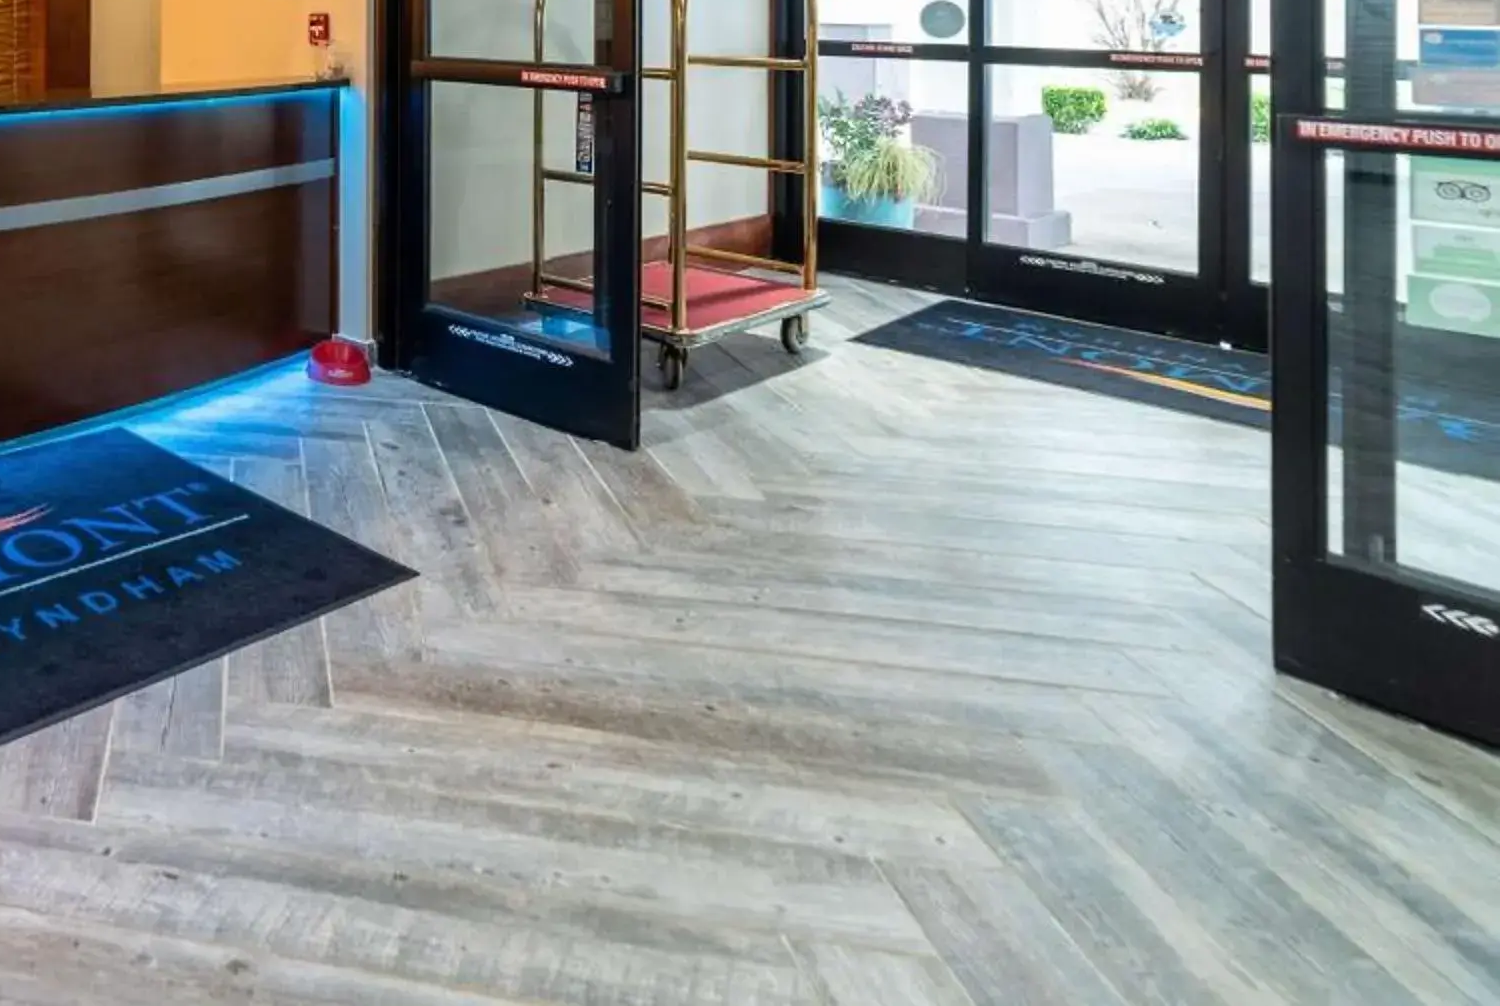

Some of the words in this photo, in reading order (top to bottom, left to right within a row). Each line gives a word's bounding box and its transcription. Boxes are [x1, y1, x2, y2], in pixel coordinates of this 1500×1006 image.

[1317, 122, 1412, 143] EMERGENCY
[1411, 128, 1456, 147] PUSH
[1459, 131, 1481, 148] TO
